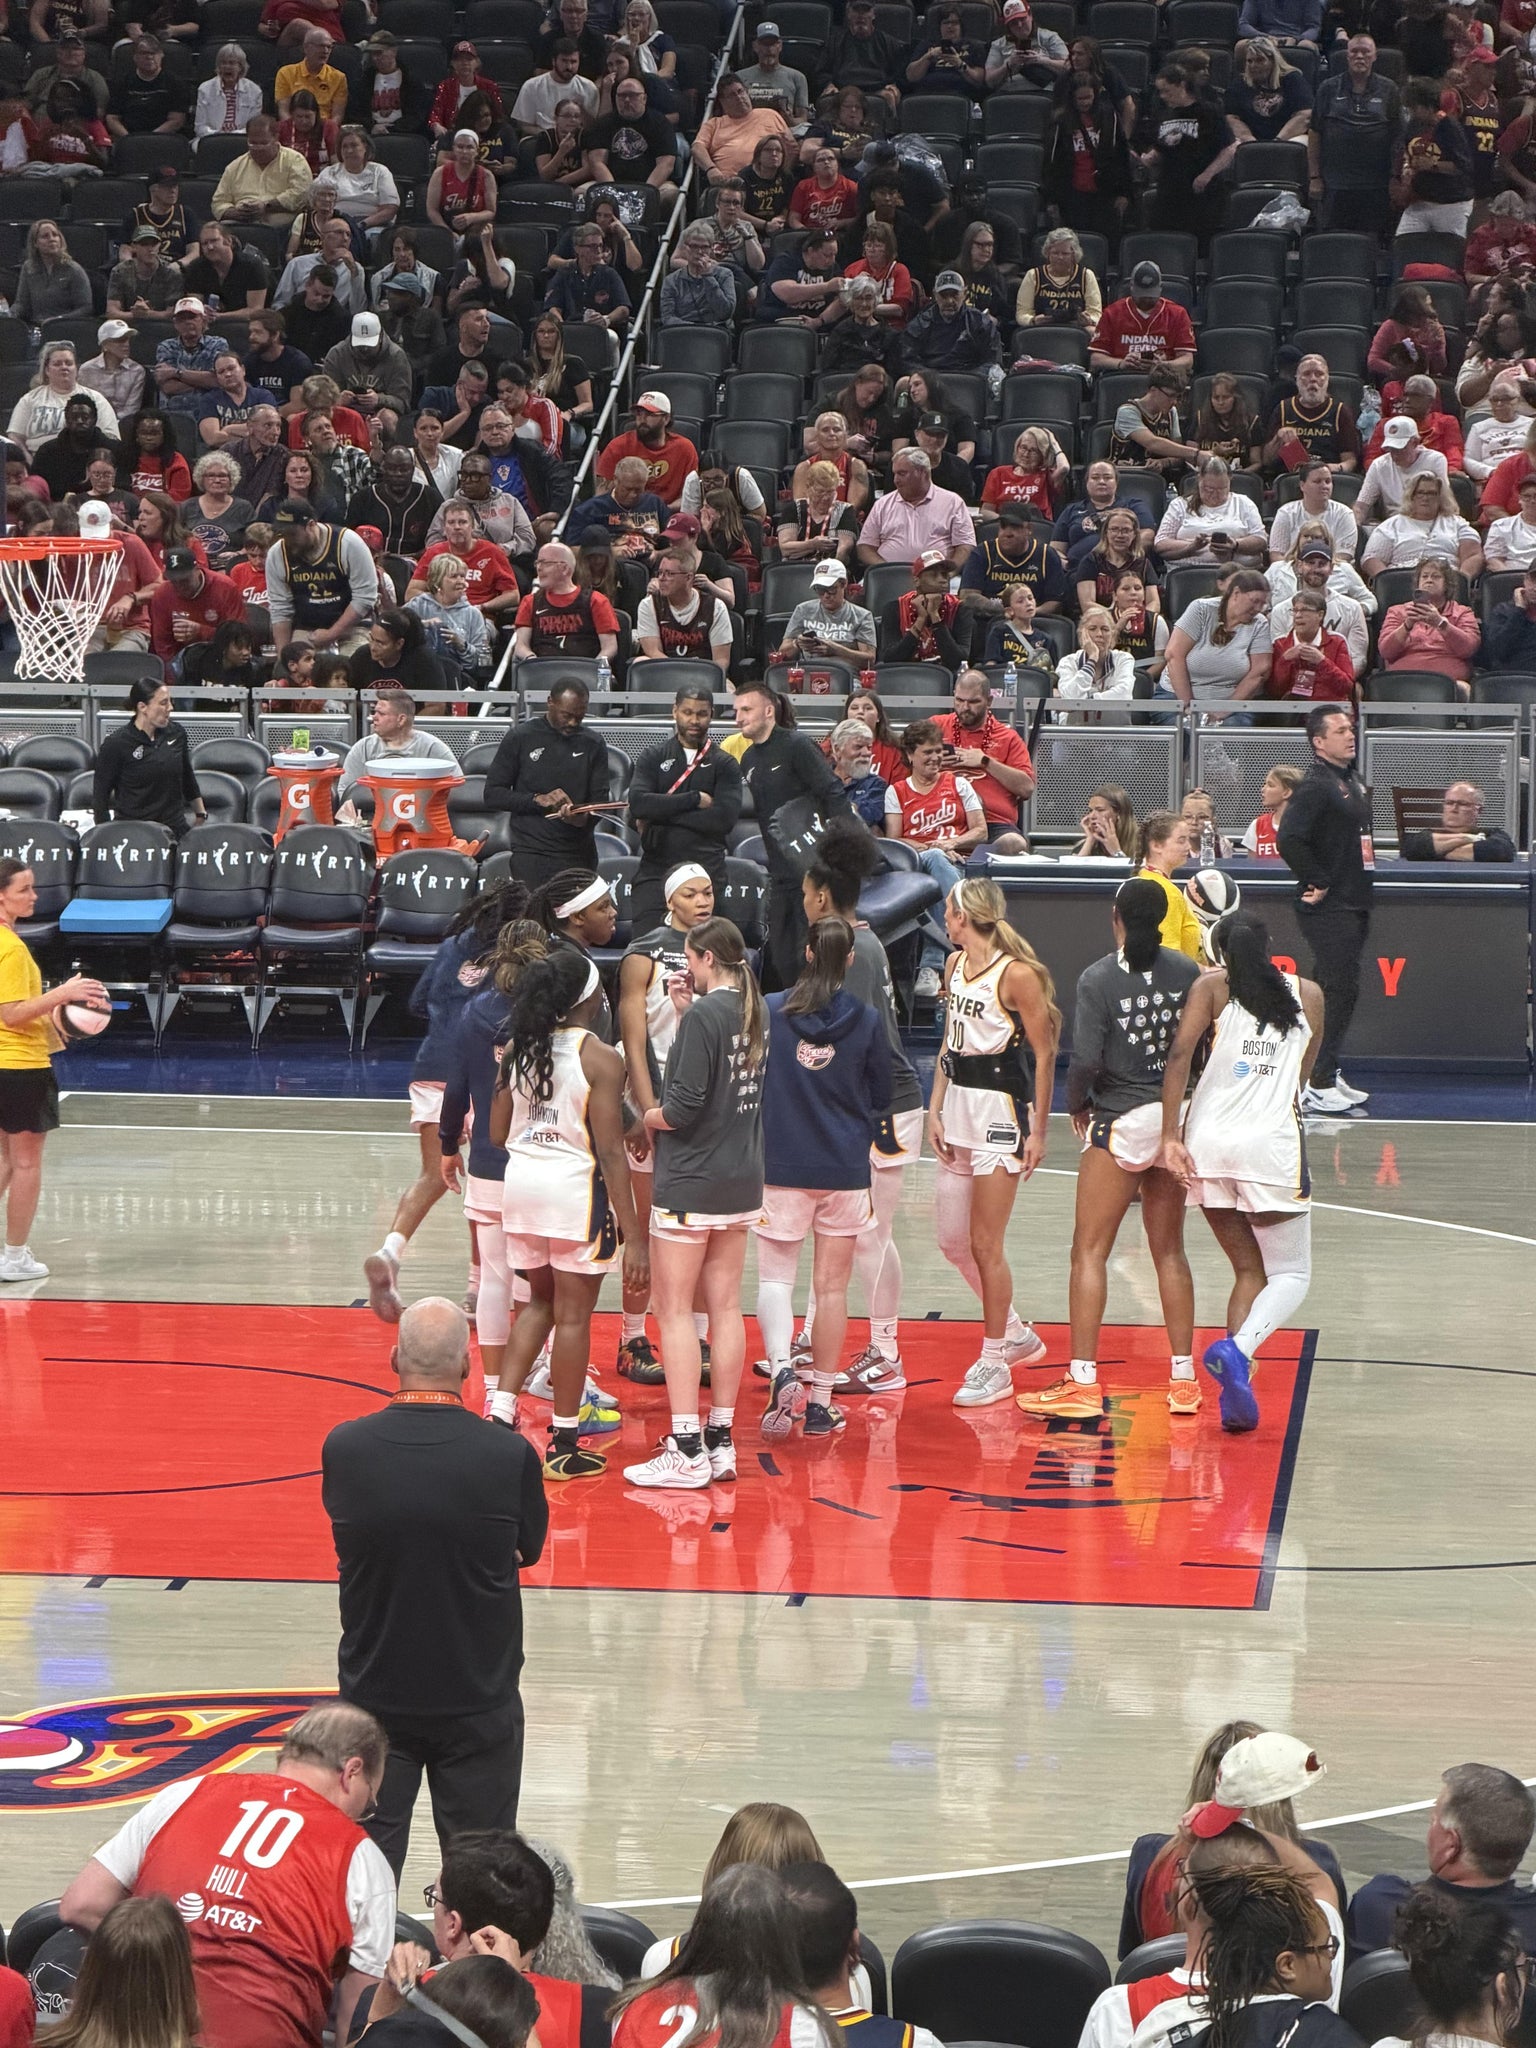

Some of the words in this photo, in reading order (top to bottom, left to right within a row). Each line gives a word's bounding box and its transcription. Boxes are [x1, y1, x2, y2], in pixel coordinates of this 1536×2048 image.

[809, 196, 843, 219] Indy
[1039, 291, 1083, 299] INDIANA
[1121, 334, 1167, 346] INDIANA
[1004, 485, 1039, 495] FEVER
[293, 573, 337, 583] INDIANA
[991, 572, 1038, 583] INDIANA
[803, 619, 854, 632] INDIANA
[556, 635, 567, 649] 7
[817, 631, 847, 641] EVER
[1003, 640, 1028, 656] INDIA
[287, 783, 310, 810] G
[392, 793, 416, 820] G
[910, 797, 957, 836] Indy
[937, 825, 959, 841] 22
[952, 1019, 965, 1051] 10
[1242, 1039, 1277, 1057] BOSTON
[1251, 1063, 1278, 1077] AT&T
[532, 1131, 561, 1143] AT&T
[218, 1800, 305, 1869] 10
[205, 1864, 249, 1900] HULL
[203, 1904, 263, 1934] AT&T
